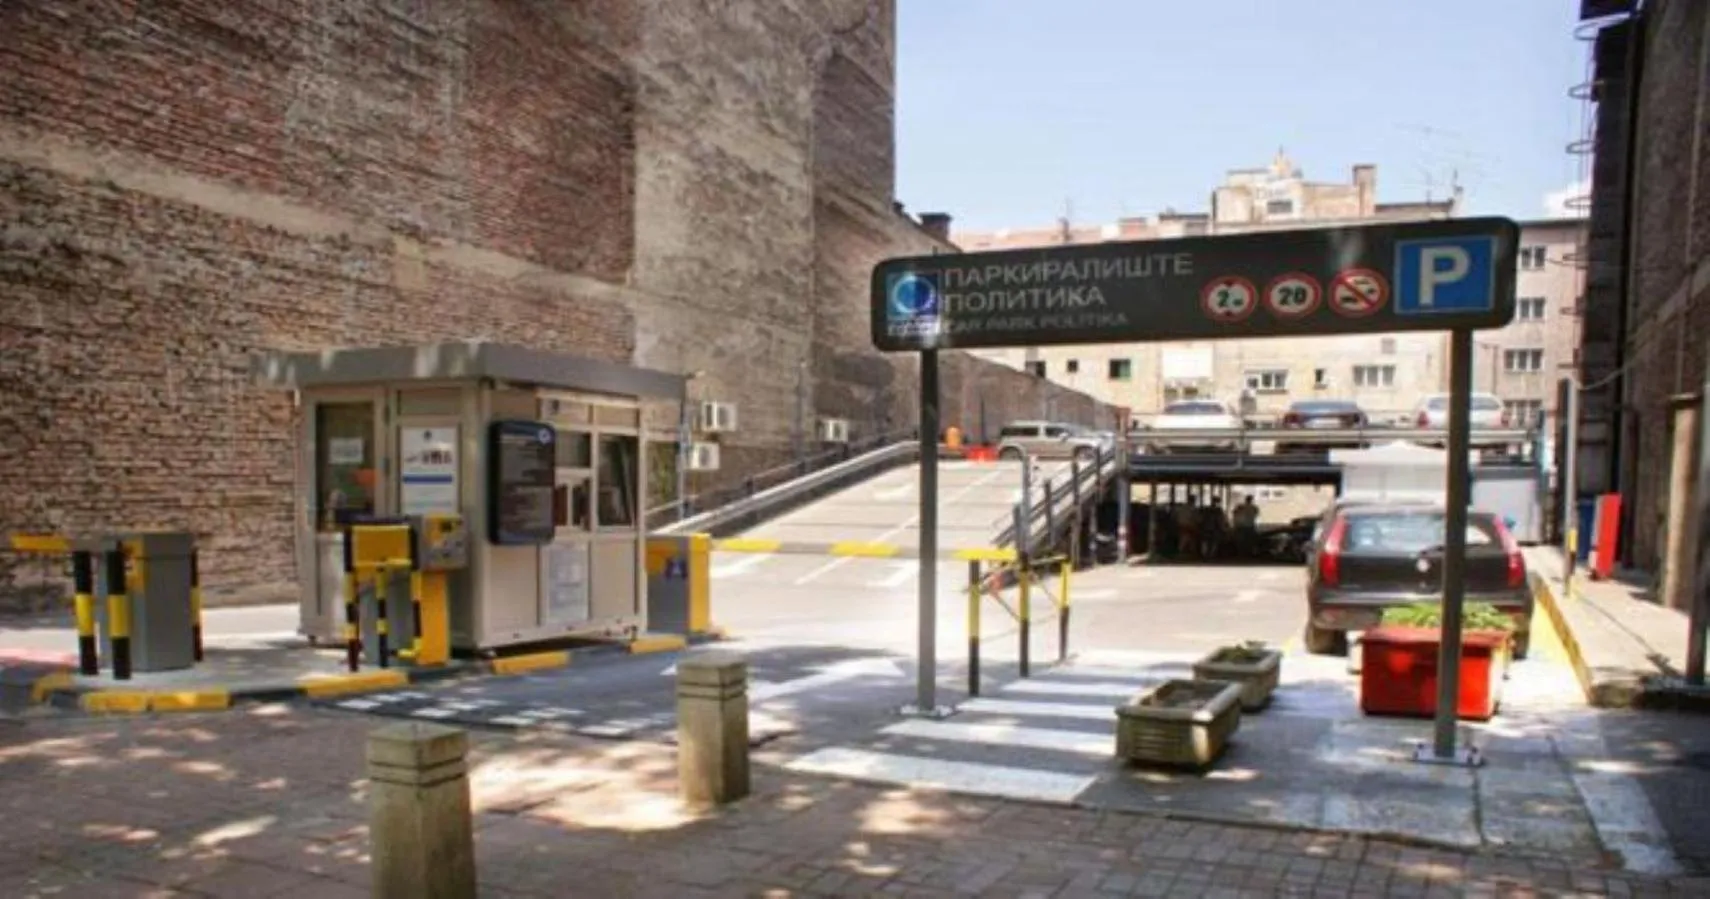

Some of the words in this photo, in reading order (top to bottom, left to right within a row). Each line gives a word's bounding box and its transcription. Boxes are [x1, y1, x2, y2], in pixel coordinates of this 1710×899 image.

[944, 253, 1193, 287] ПАРКИРАЛИШТЕ
[1418, 247, 1470, 305] P
[944, 286, 1107, 313] ПОЛИТИКА
[1278, 286, 1307, 305] 20
